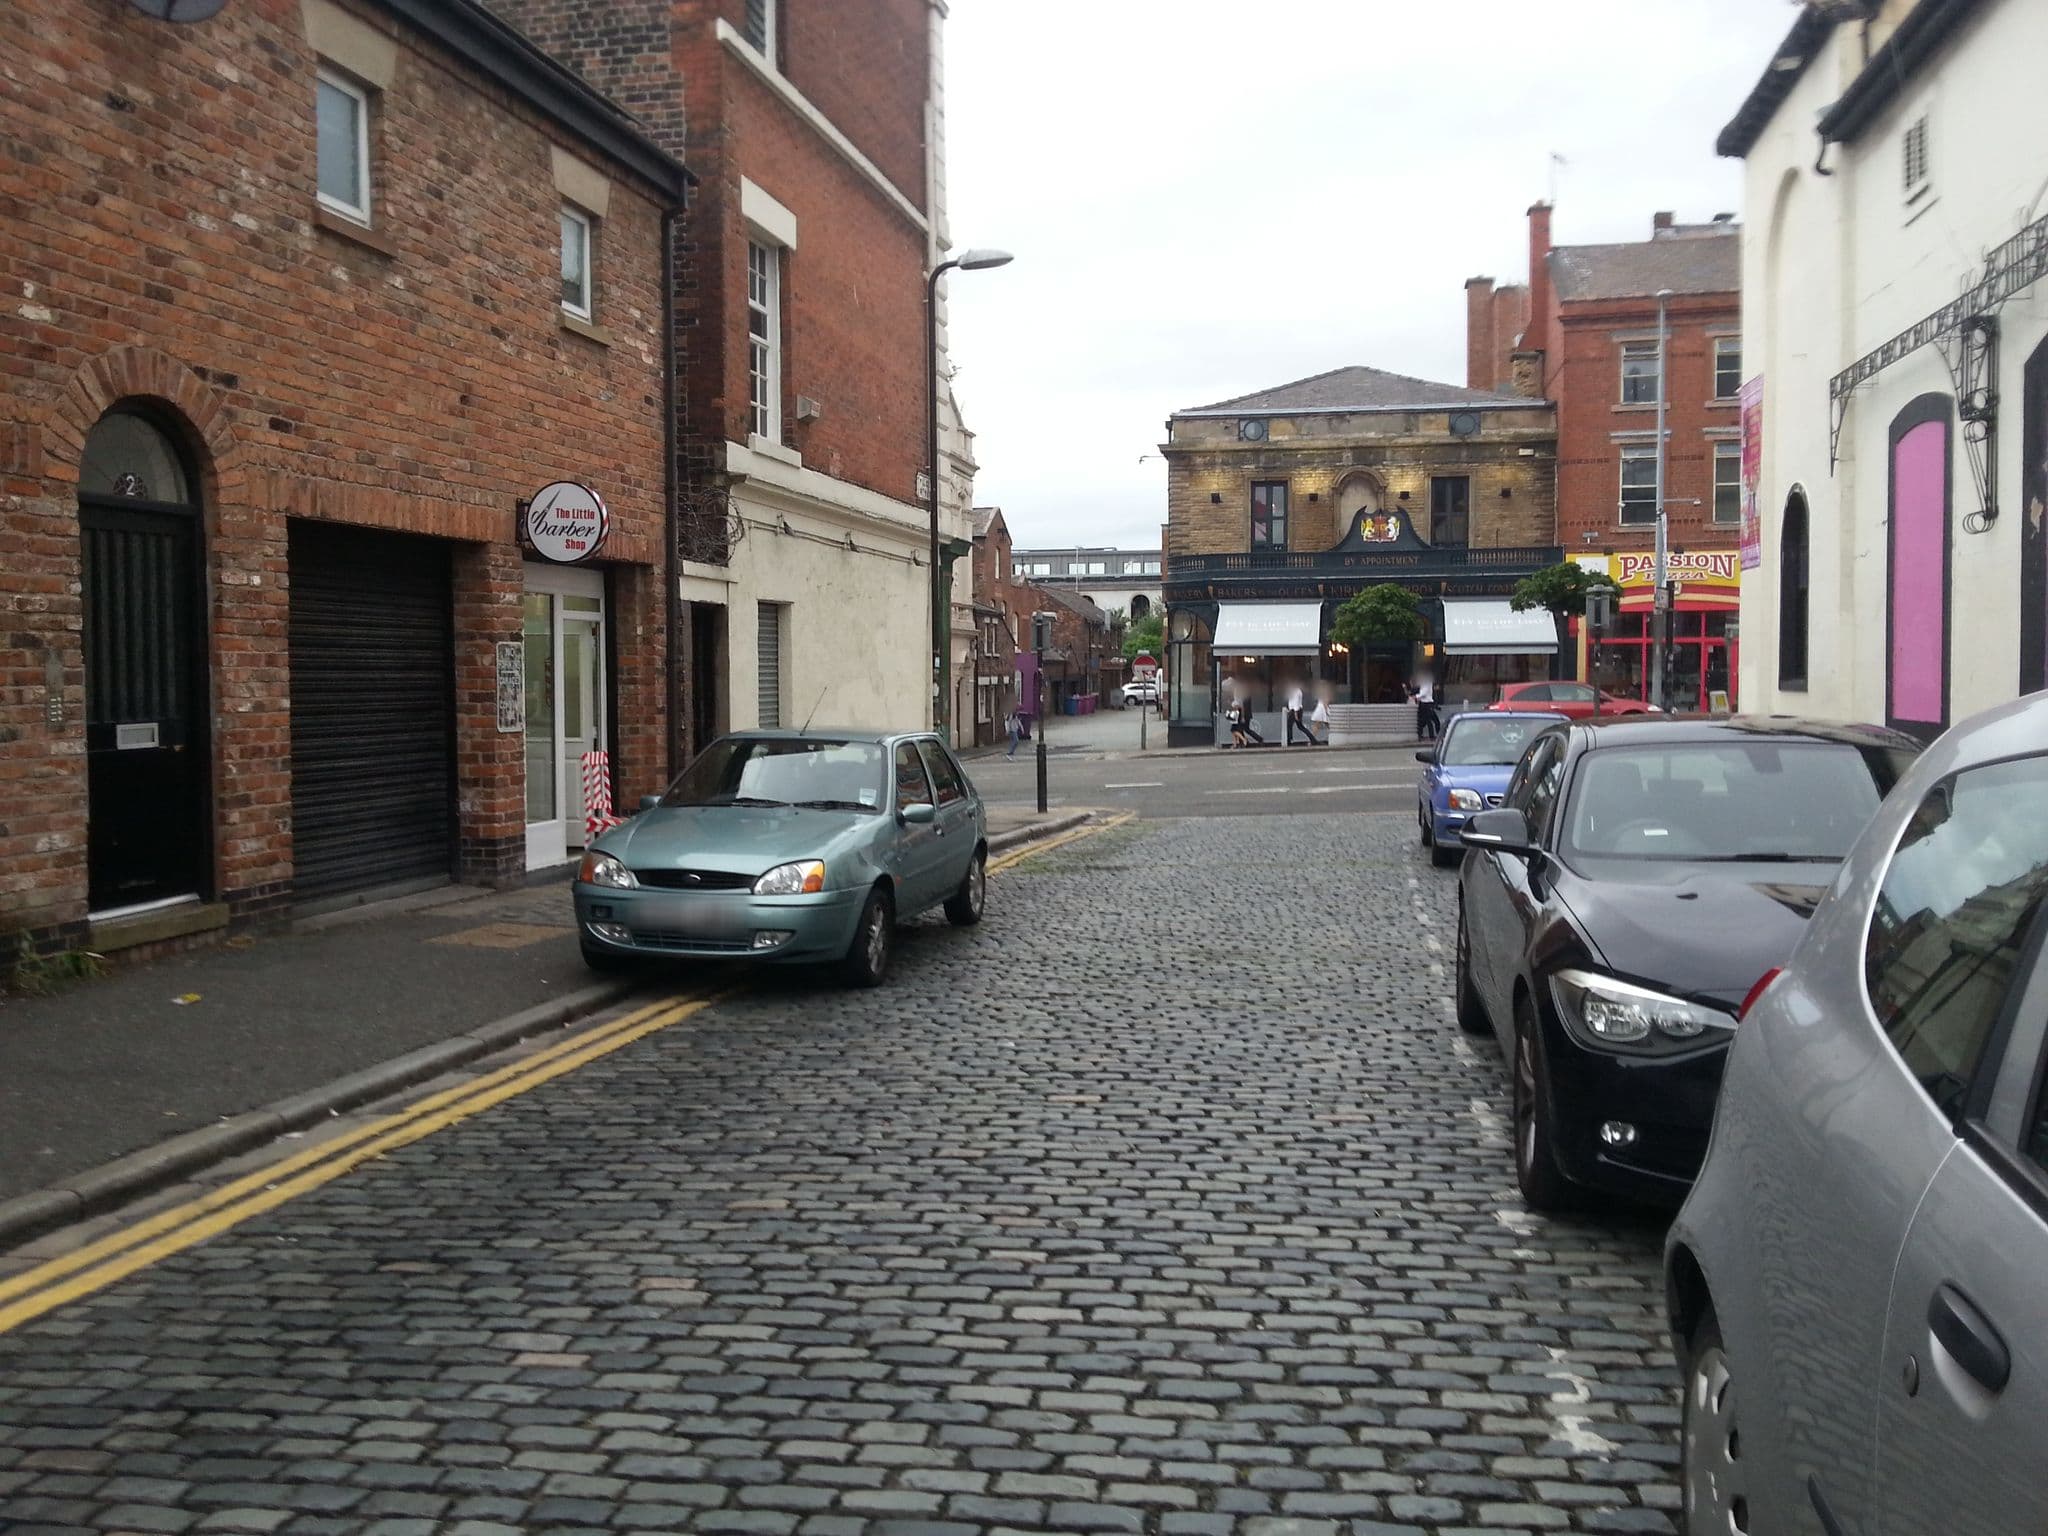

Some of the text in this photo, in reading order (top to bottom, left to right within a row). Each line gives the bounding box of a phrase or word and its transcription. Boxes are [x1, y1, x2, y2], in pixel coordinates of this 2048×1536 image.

[127, 475, 135, 496] 2
[556, 507, 595, 520] The Little
[565, 538, 586, 551] Shop
[1344, 555, 1420, 568] BY APPOINTMENT
[1619, 554, 1737, 581] PASION
[1645, 571, 1706, 580] PZZA
